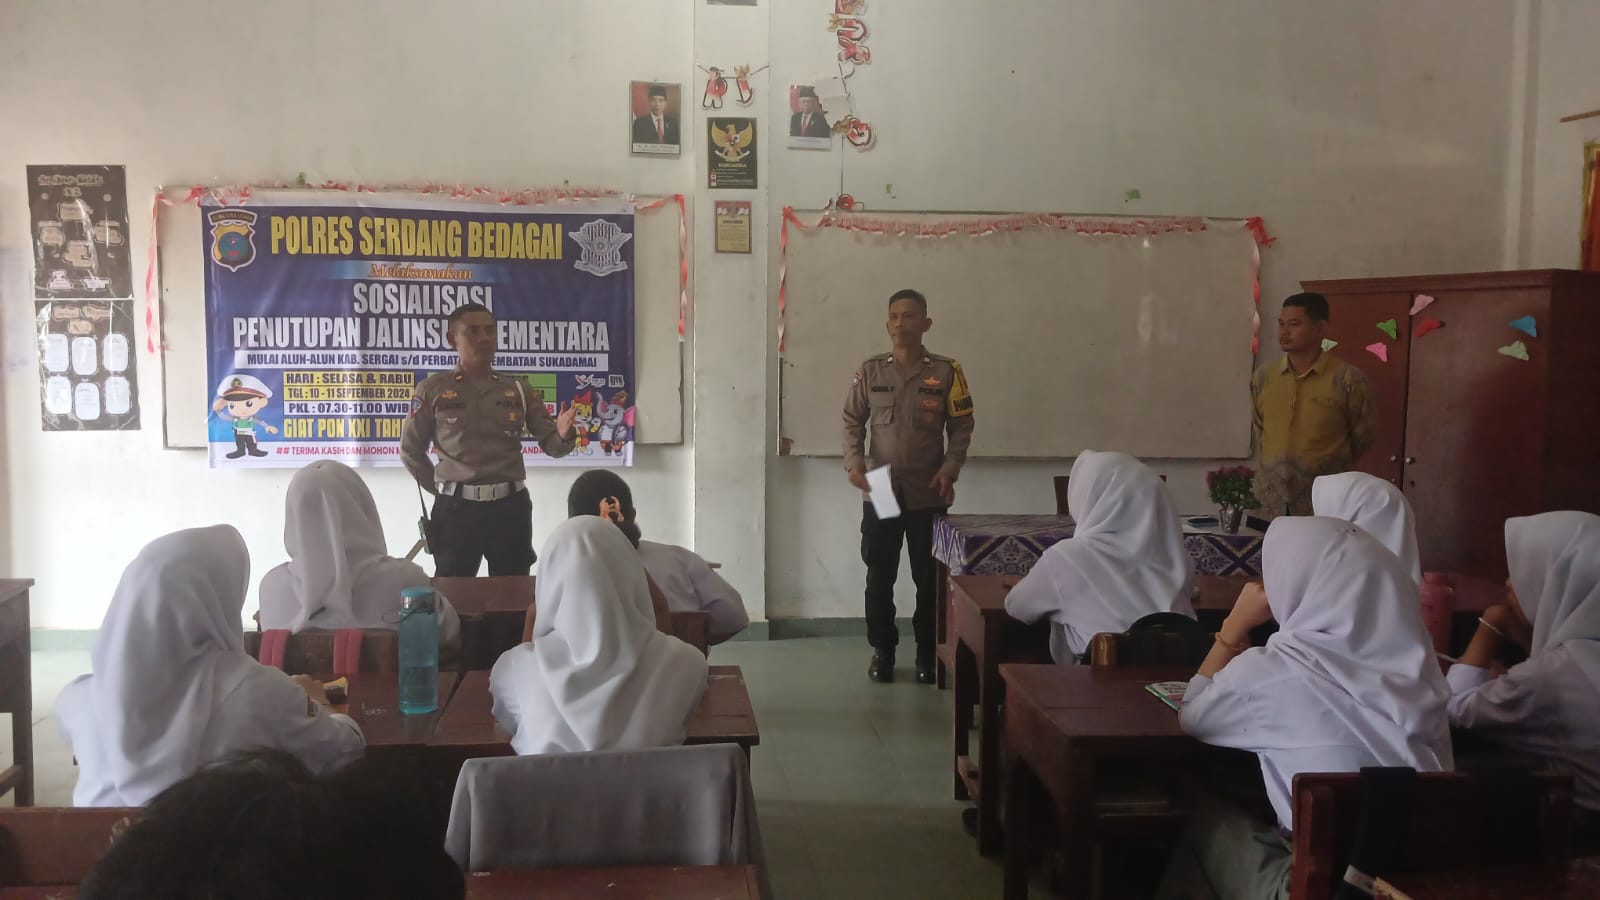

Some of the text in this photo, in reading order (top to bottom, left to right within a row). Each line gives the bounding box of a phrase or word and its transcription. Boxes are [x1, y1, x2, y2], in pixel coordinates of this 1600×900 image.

[270, 215, 563, 260] POLRES SERDANG BEDAGAI
[369, 262, 472, 280] Melaksanakan
[353, 282, 493, 316] SOSIALISASI
[233, 317, 610, 351] PENUTUPAN JALINSU EMENTARA
[247, 353, 597, 368] MULAI ALUN-ALUN KAB. SERGAI s/d PERBAT EMBATAN SUKADAMAI
[286, 373, 314, 384] HARI
[322, 373, 364, 384] SELASA
[366, 373, 377, 384] &
[379, 373, 412, 385] RABU
[288, 387, 304, 399] TGL
[310, 387, 319, 398] 10
[327, 387, 335, 398] 11
[336, 387, 386, 398] SEPTEMBER
[387, 388, 411, 398] 2024
[289, 403, 310, 413] PKL
[317, 403, 383, 413] 07.30-11.00
[385, 403, 409, 413] WIB
[284, 418, 405, 438] GIAT PON XXI TAH
[292, 447, 320, 455] TERIMA
[321, 447, 345, 455] KASIH
[346, 447, 362, 455] DAN
[363, 447, 394, 455] MOHON
